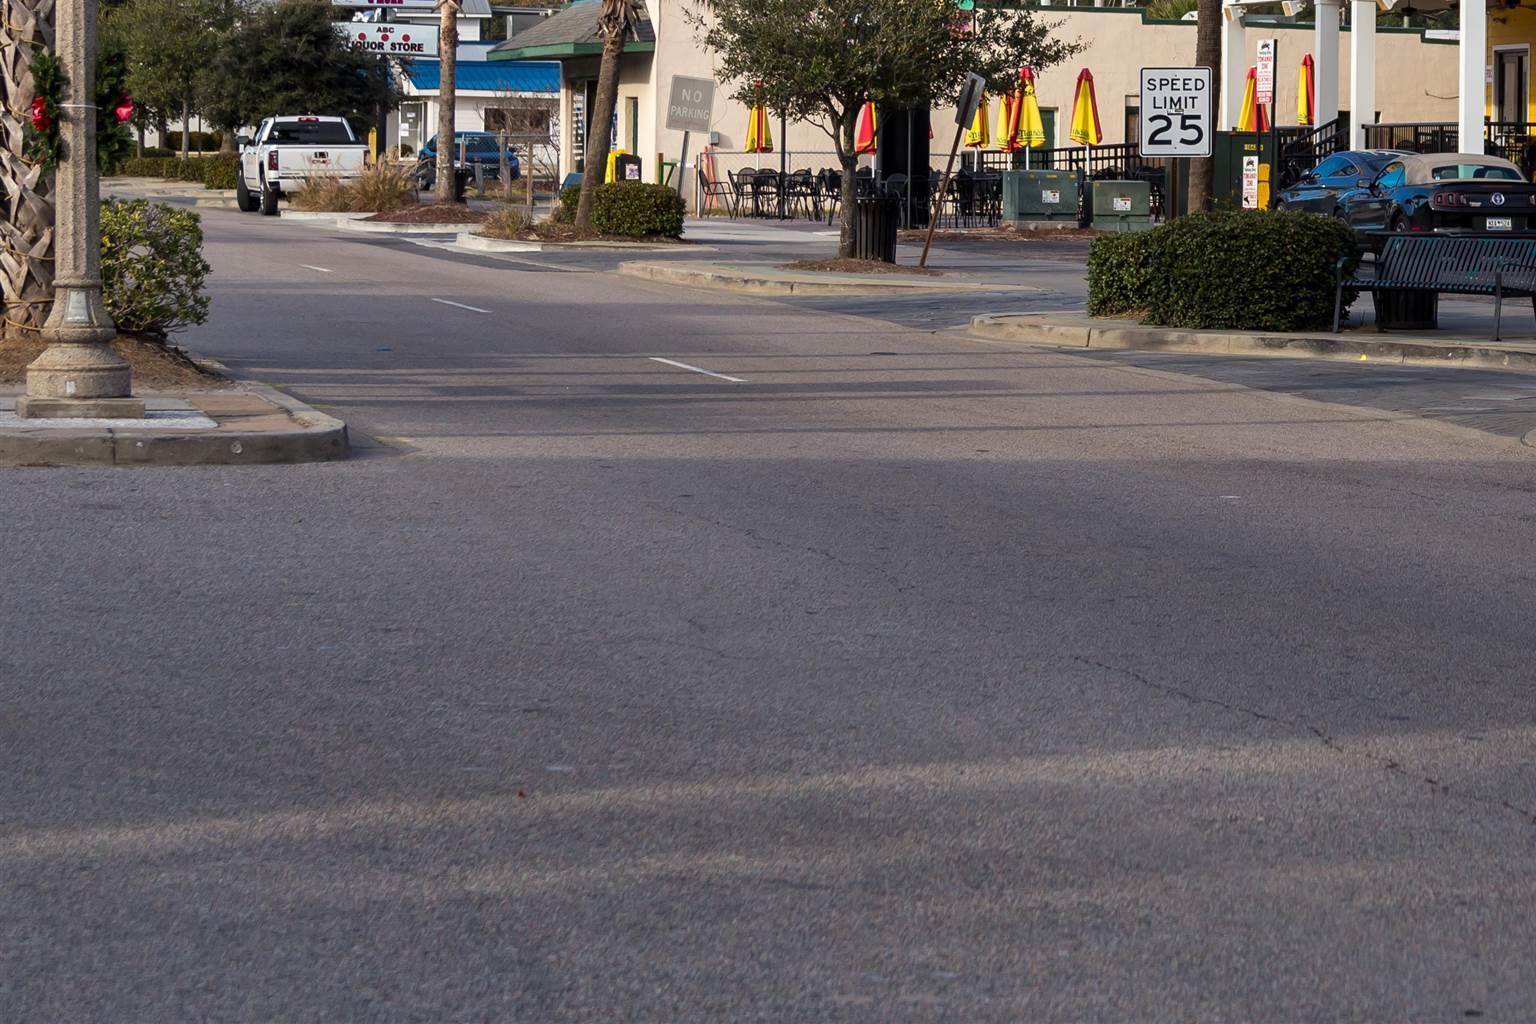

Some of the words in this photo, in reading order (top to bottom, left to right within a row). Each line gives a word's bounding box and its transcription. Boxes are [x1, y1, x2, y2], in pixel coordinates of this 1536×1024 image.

[390, 42, 424, 52] STORE
[1147, 78, 1205, 91] SPEED
[681, 88, 703, 103] NO
[1153, 96, 1198, 109] LIMIT
[671, 105, 710, 120] PARKING
[1147, 114, 1204, 146] 25
